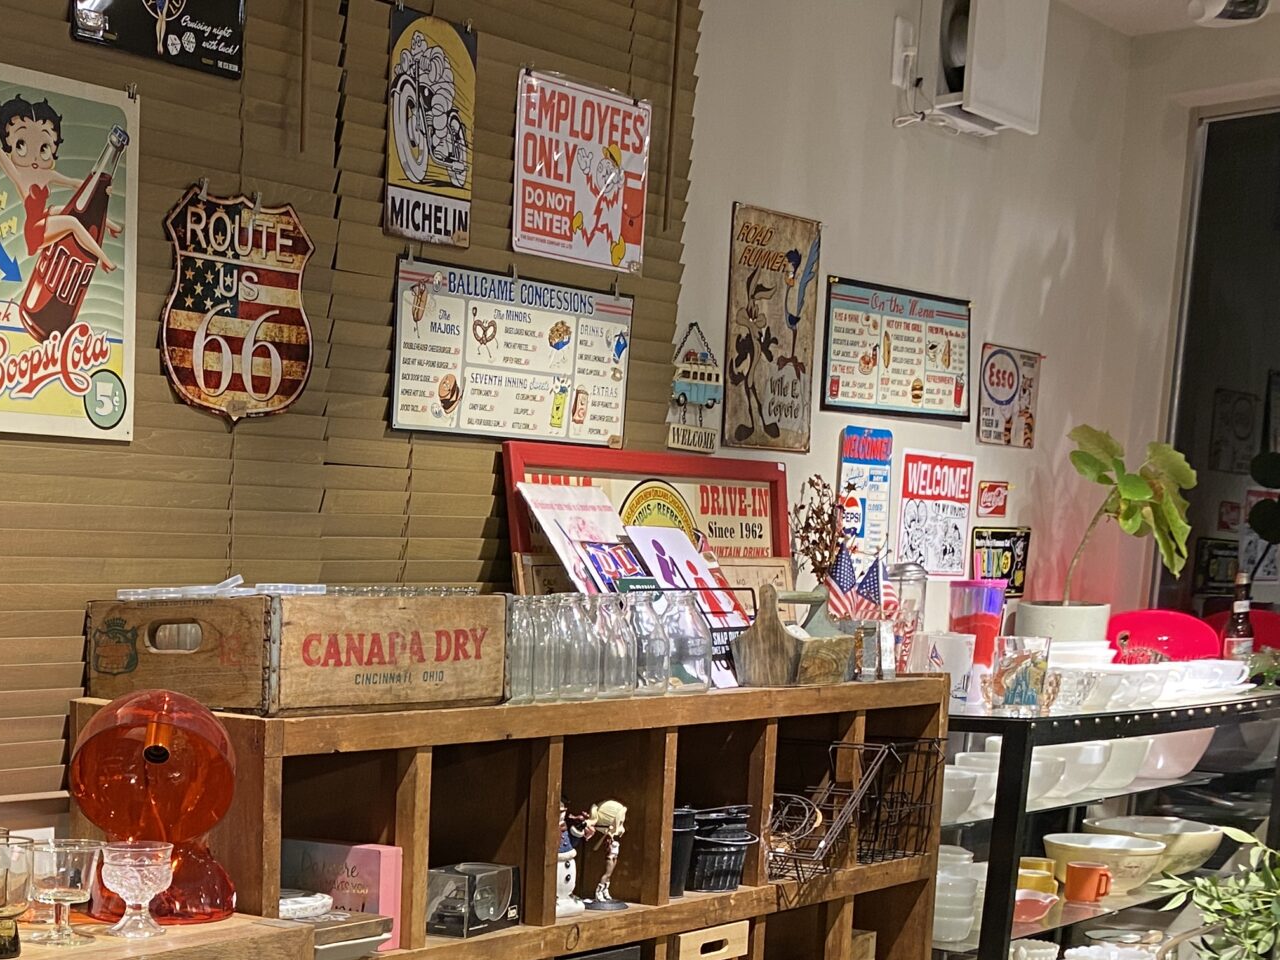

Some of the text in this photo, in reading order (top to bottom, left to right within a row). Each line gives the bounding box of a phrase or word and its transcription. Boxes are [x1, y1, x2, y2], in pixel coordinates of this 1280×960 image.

[181, 15, 233, 40] Cruising night
[202, 40, 239, 55] with luck!
[524, 83, 645, 155] EMPLOYEES
[522, 131, 578, 184] ONLY
[525, 187, 573, 211] DO NOT
[390, 196, 469, 238] MICHELIN
[524, 211, 572, 236] ENTER
[186, 206, 295, 264] ROUTE
[736, 222, 774, 247] ROAD
[738, 246, 788, 274] RUNNER
[220, 267, 259, 301] US
[448, 271, 594, 315] BALLGAME CONCESSIONS
[505, 310, 532, 323] MINORS
[870, 292, 935, 319] On the Menu
[429, 321, 460, 336] MAJORS
[579, 324, 604, 338] DRINKS
[56, 322, 110, 398] Cola
[192, 303, 282, 402] 66
[470, 372, 503, 387] SEVENTH
[504, 376, 527, 389] INNING
[592, 385, 618, 399] EXTRAS
[770, 375, 788, 398] Wile
[768, 400, 800, 423] Coyote
[672, 426, 716, 450] WELCOME
[843, 435, 892, 461] WELCOME!
[907, 461, 972, 499] WELCOME!
[699, 484, 769, 518] DRIVE-IN
[842, 511, 861, 524] PEPSI
[708, 522, 763, 540] Since 1962
[743, 546, 770, 558] DRINKS
[434, 627, 489, 662] DRY
[422, 670, 445, 683] OHIO
